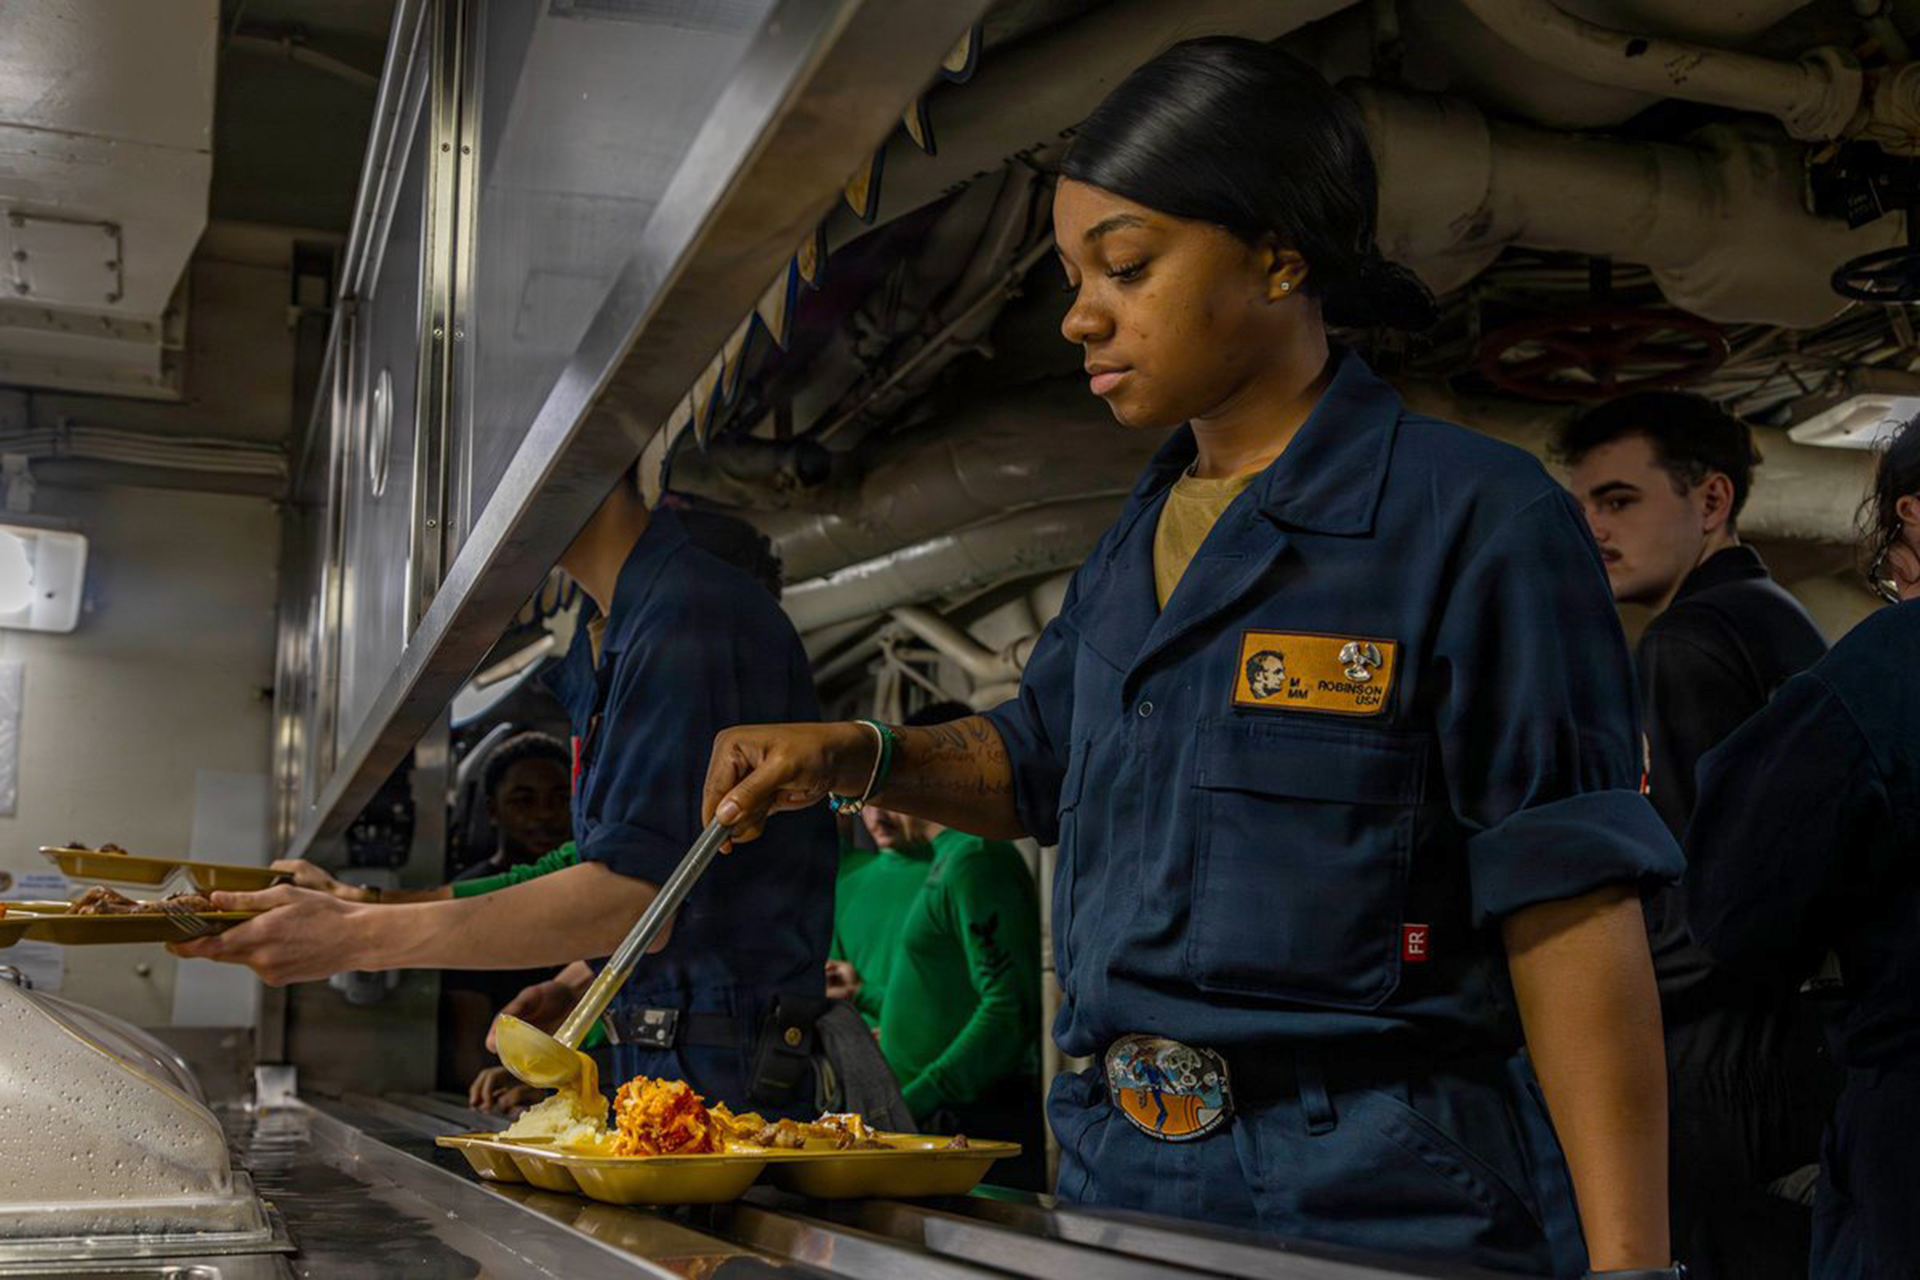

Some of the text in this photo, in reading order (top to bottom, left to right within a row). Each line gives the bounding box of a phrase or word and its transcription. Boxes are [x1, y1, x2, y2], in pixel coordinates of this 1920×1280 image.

[1318, 680, 1382, 695] ROBINSON
[1288, 688, 1380, 705] MM USN
[1408, 932, 1425, 954] FR
